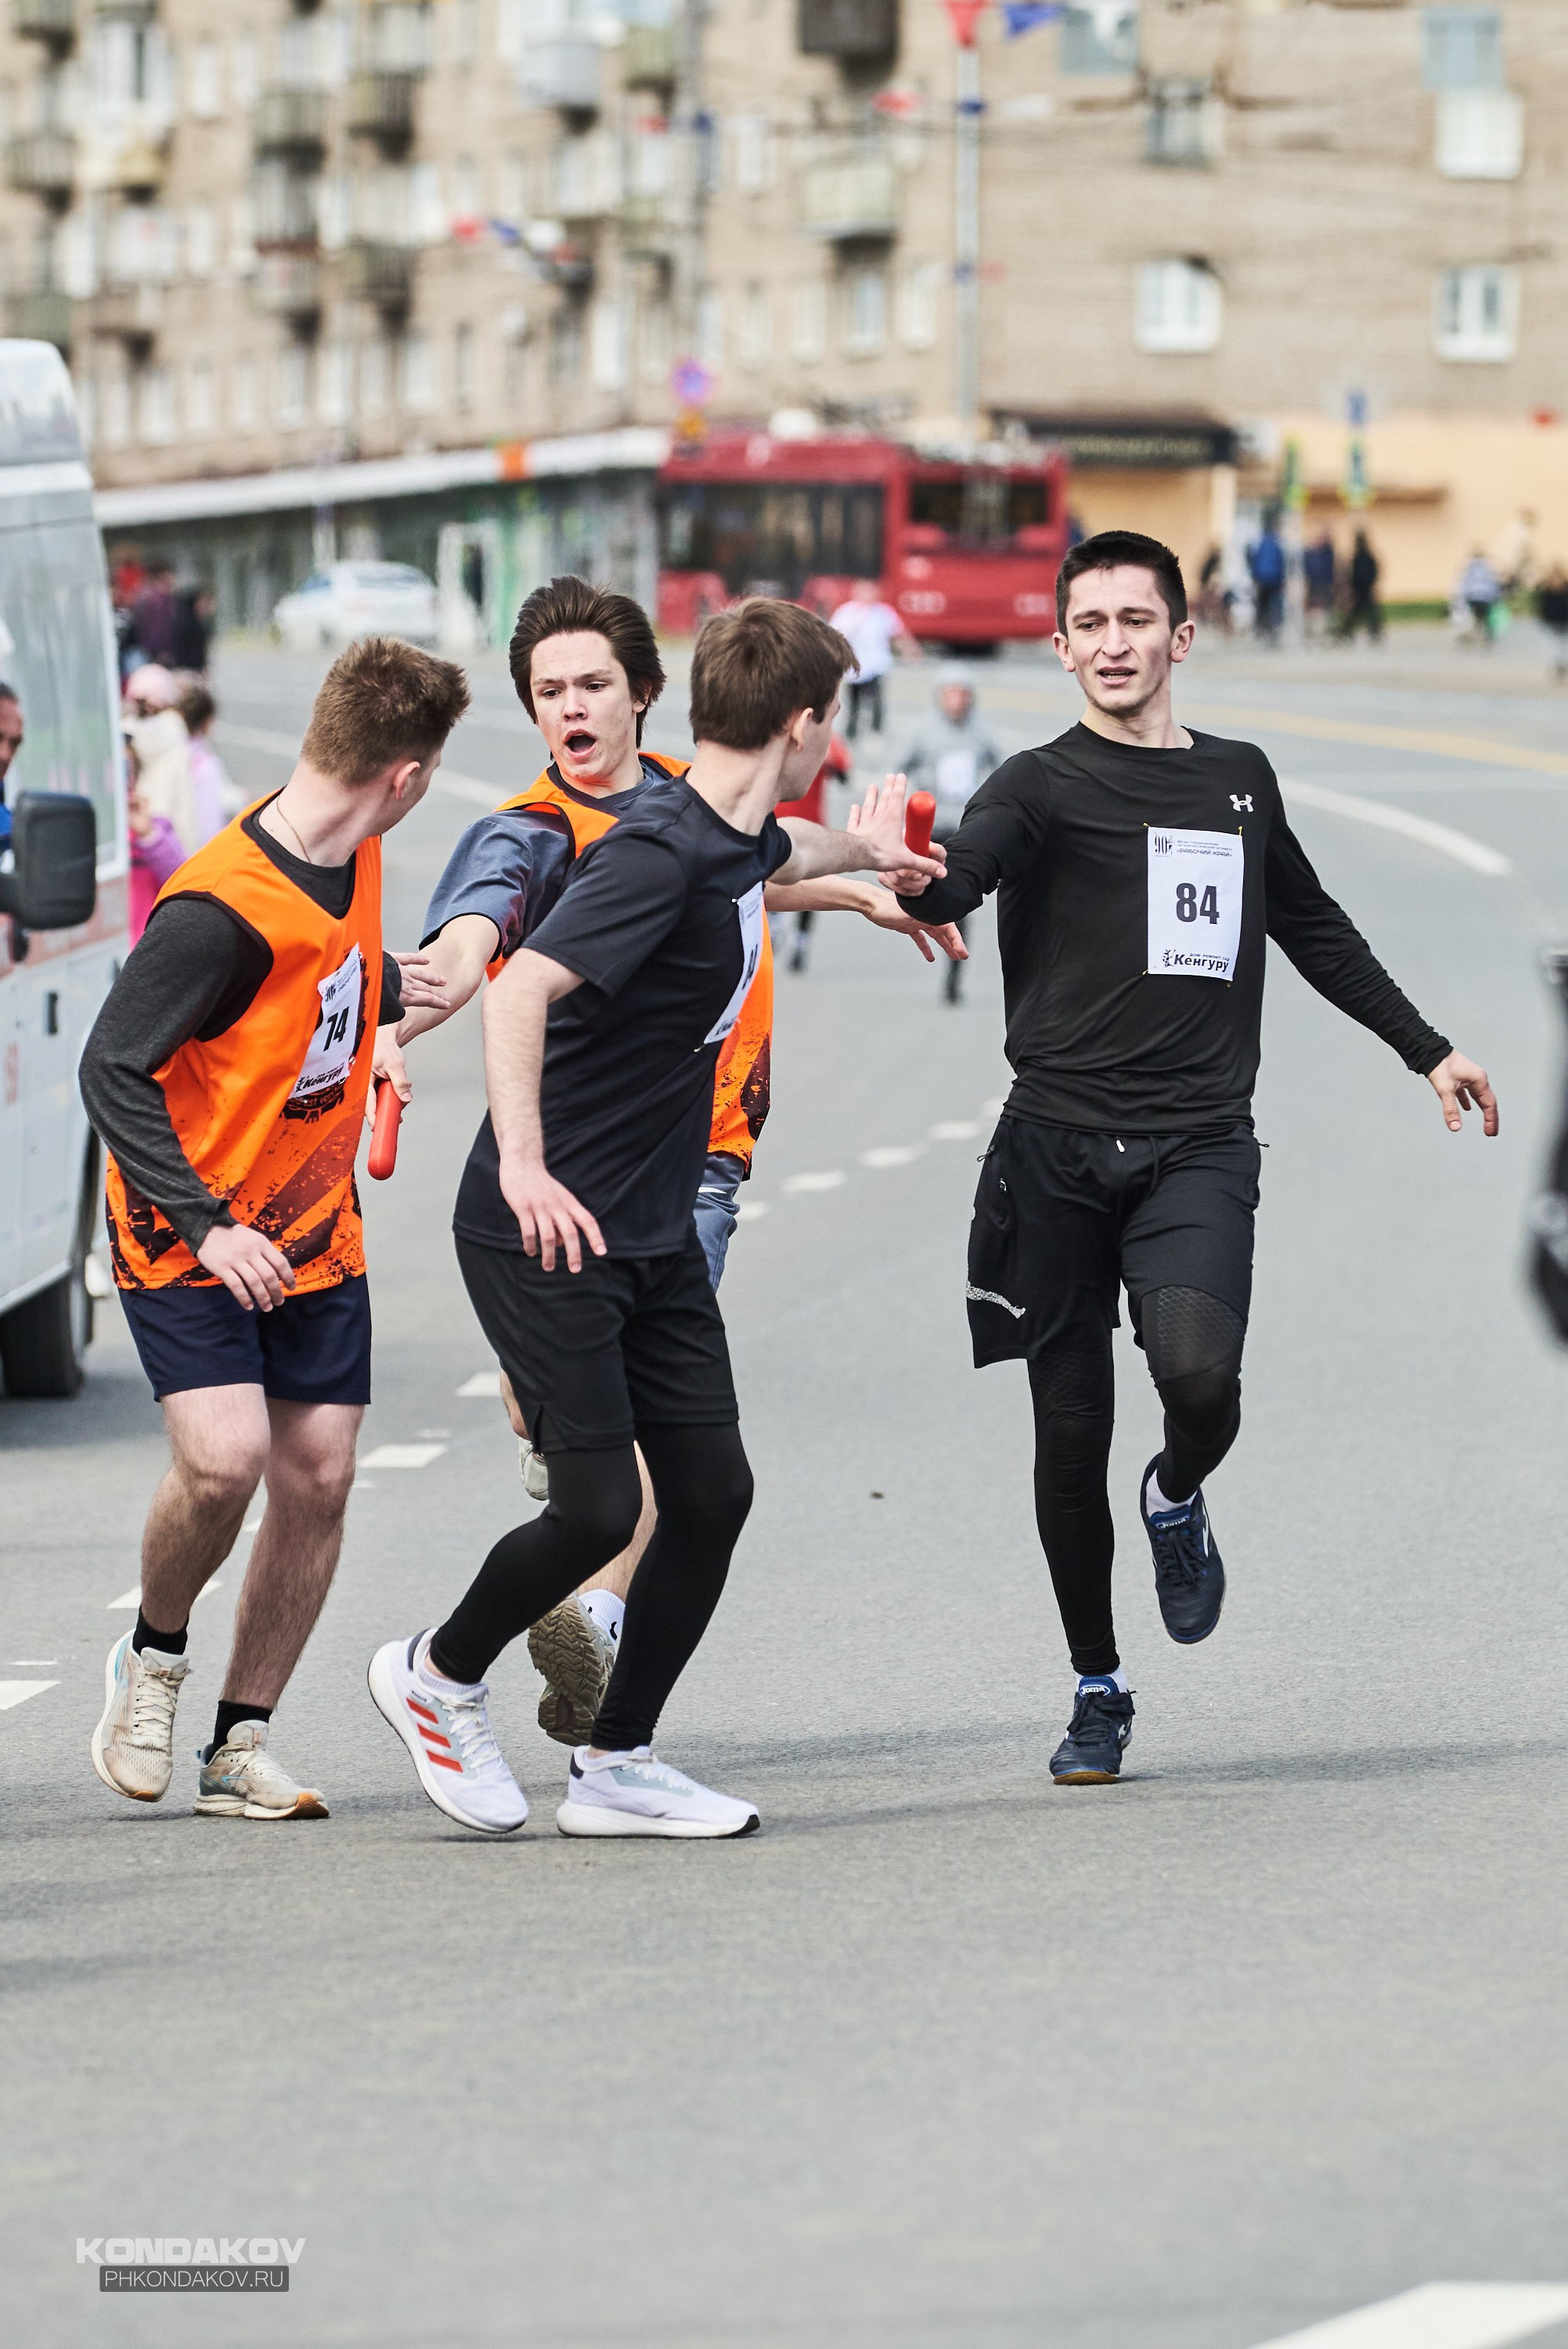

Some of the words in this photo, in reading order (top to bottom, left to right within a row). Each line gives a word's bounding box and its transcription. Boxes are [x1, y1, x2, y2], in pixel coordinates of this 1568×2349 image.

[1176, 882, 1220, 925] 84
[1173, 954, 1229, 972] Кенгуру
[323, 1006, 350, 1052] 74
